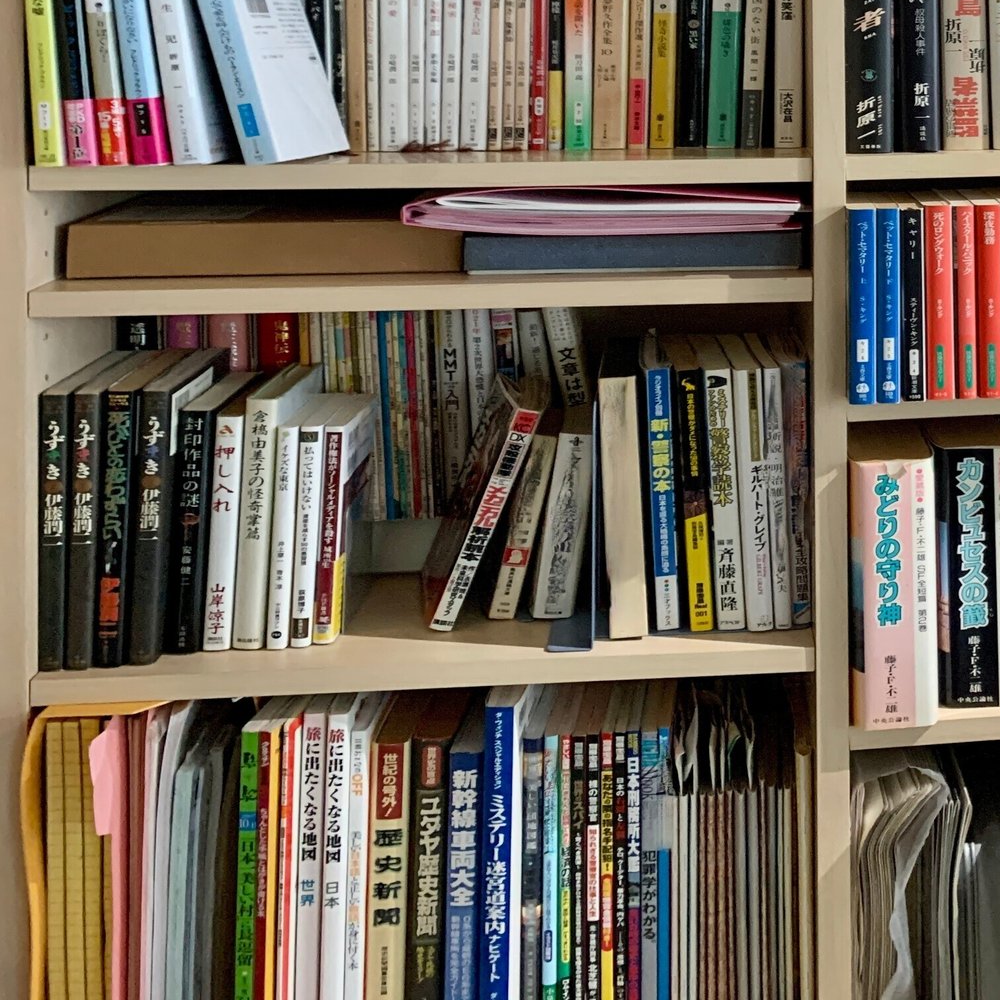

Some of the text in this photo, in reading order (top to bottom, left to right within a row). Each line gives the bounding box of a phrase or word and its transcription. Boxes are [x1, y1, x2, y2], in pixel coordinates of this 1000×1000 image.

[657, 19, 667, 57] 怪奇小説集
[945, 18, 962, 52] 折原一
[783, 92, 793, 123] 大沢在昌
[856, 96, 876, 140] 折原一
[914, 82, 930, 119] 折原一
[856, 221, 867, 274] ペット・セマタリー
[883, 220, 893, 276] ペット・セマタリー
[907, 216, 916, 260] キャリー
[933, 212, 944, 276] 死のロングウォーク
[983, 211, 996, 245] 深夜勤務
[444, 349, 457, 381] MMT
[183, 418, 204, 508] 封印作品の謎
[279, 445, 289, 492] イケズな東京
[509, 433, 528, 441] DX
[650, 419, 671, 494] 新・警察の本
[709, 428, 734, 508] 警察学読本
[213, 447, 235, 513] 押し入れ
[245, 411, 269, 541] 倉橋由美子の怪奇掌篇
[301, 446, 314, 511] 払ってはいけない
[44, 494, 64, 547] 伊藤潤二
[72, 493, 93, 545] 伊藤潤二
[140, 488, 161, 542] 伊藤潤二
[750, 465, 768, 552] ギルバート・グレイプ
[875, 475, 903, 626] みどりの守り神
[956, 458, 990, 629] カンビュセスの籤
[718, 548, 738, 612] 斉藤直隆
[301, 727, 321, 861] 旅に出たくなる地図
[326, 728, 345, 864] 旅に出たくなる地図
[381, 753, 398, 817] 世紀の号外！
[416, 797, 443, 936] ユダヤ歴史新聞
[450, 769, 478, 907] 新幹線車両大全
[300, 879, 315, 907] 世界
[324, 881, 339, 908] 日本
[373, 829, 403, 926] 歴史新聞
[642, 851, 657, 943] 犯罪学がわかる。
